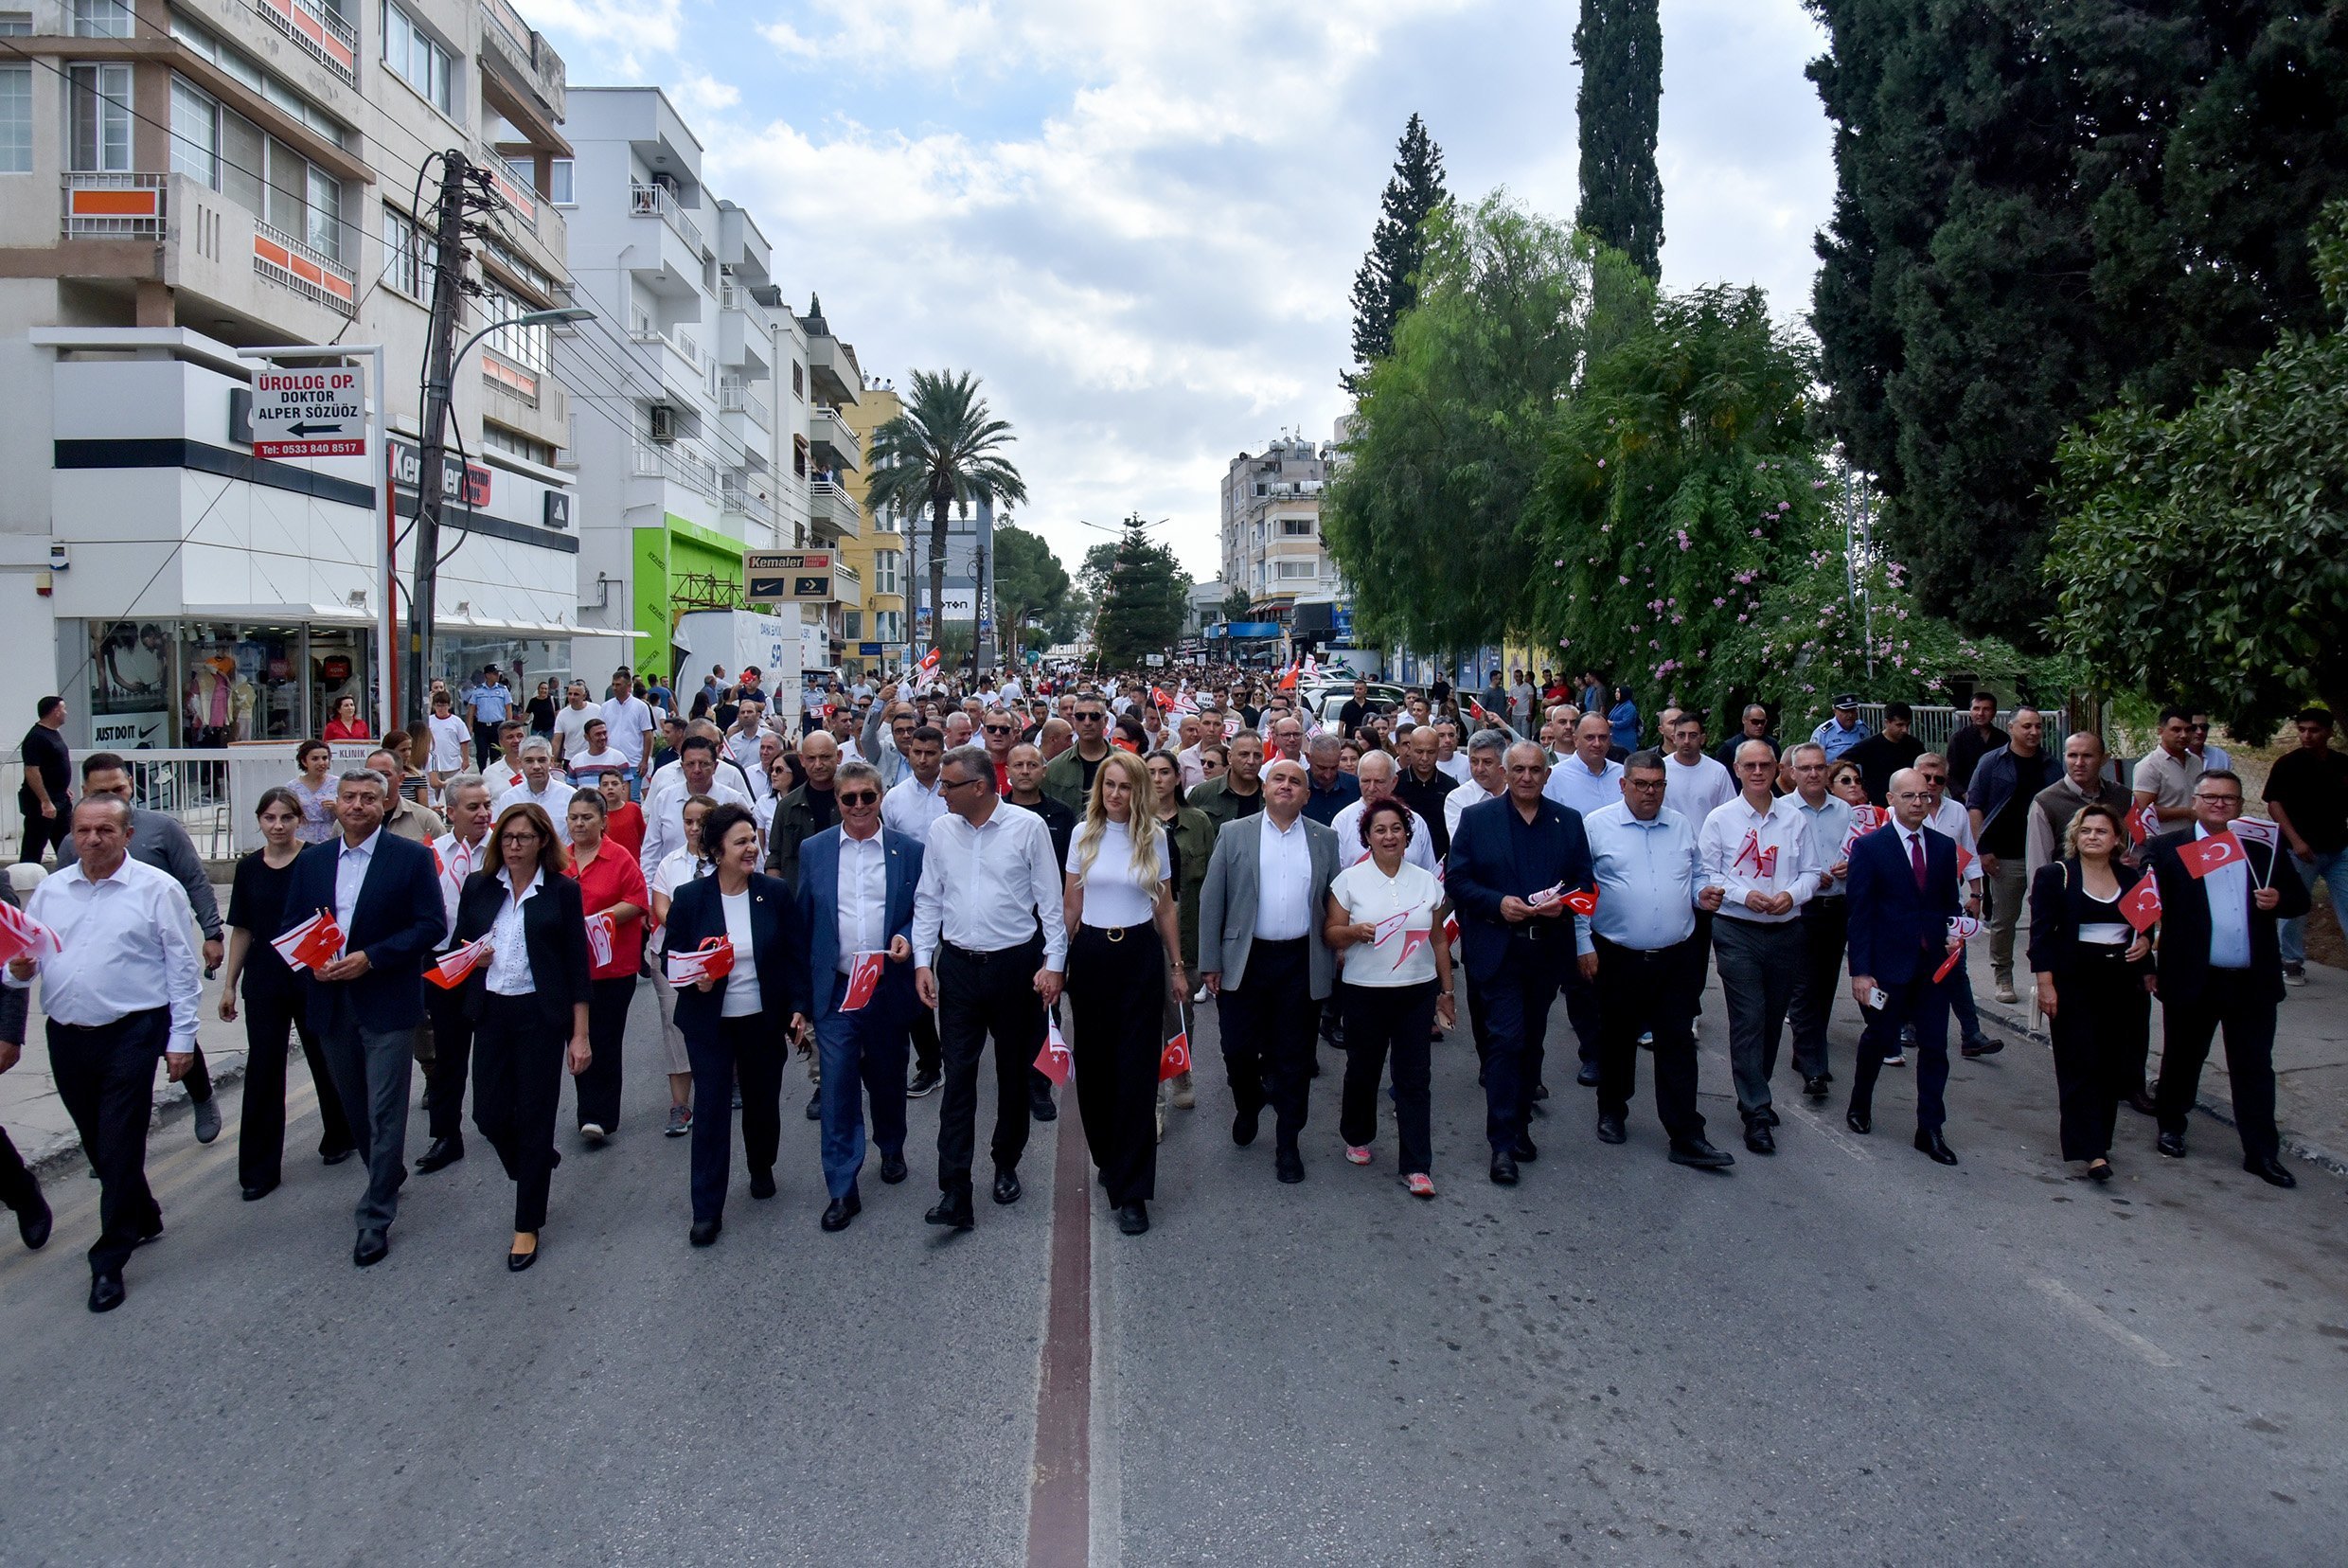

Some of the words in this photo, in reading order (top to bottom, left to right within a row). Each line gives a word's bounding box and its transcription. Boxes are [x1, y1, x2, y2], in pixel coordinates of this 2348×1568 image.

[258, 373, 325, 391] ÜROLOG
[331, 374, 355, 389] OP.
[281, 390, 334, 403] DOKTOR
[258, 405, 301, 419] ALPER
[305, 402, 358, 419] SÖZÜÖZ
[262, 445, 279, 454] Tel:
[282, 444, 307, 454] 0533
[310, 443, 329, 454] 840
[331, 443, 357, 453] 8517
[392, 443, 462, 495] Keler
[751, 557, 803, 568] Kemaler
[96, 726, 115, 741] JUST
[115, 725, 127, 740] DO
[127, 724, 135, 739] IT
[339, 747, 365, 758] KLİNİK
